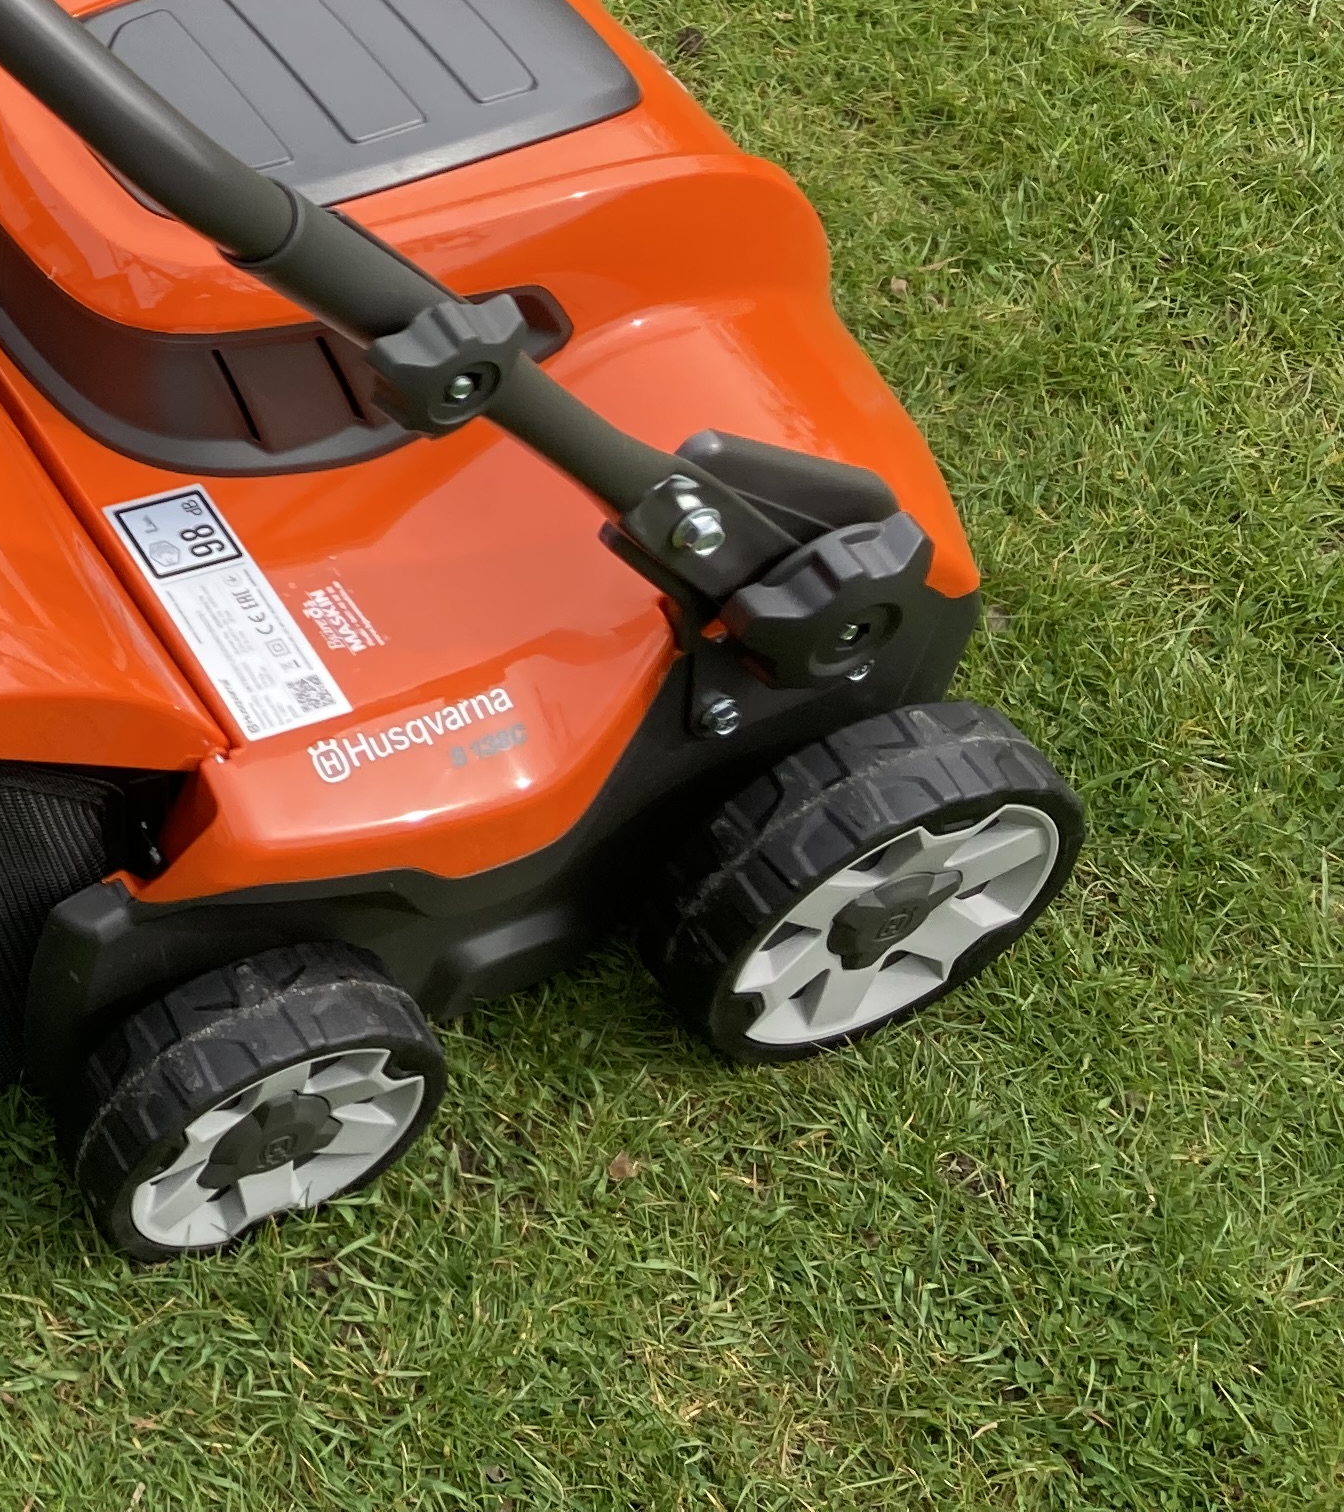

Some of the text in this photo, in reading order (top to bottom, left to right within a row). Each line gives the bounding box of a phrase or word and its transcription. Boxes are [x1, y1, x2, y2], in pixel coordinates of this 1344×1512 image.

[181, 499, 203, 516] dB
[180, 524, 225, 558] 98
[309, 589, 367, 652] MASKIN
[343, 688, 514, 768] Husqvarna
